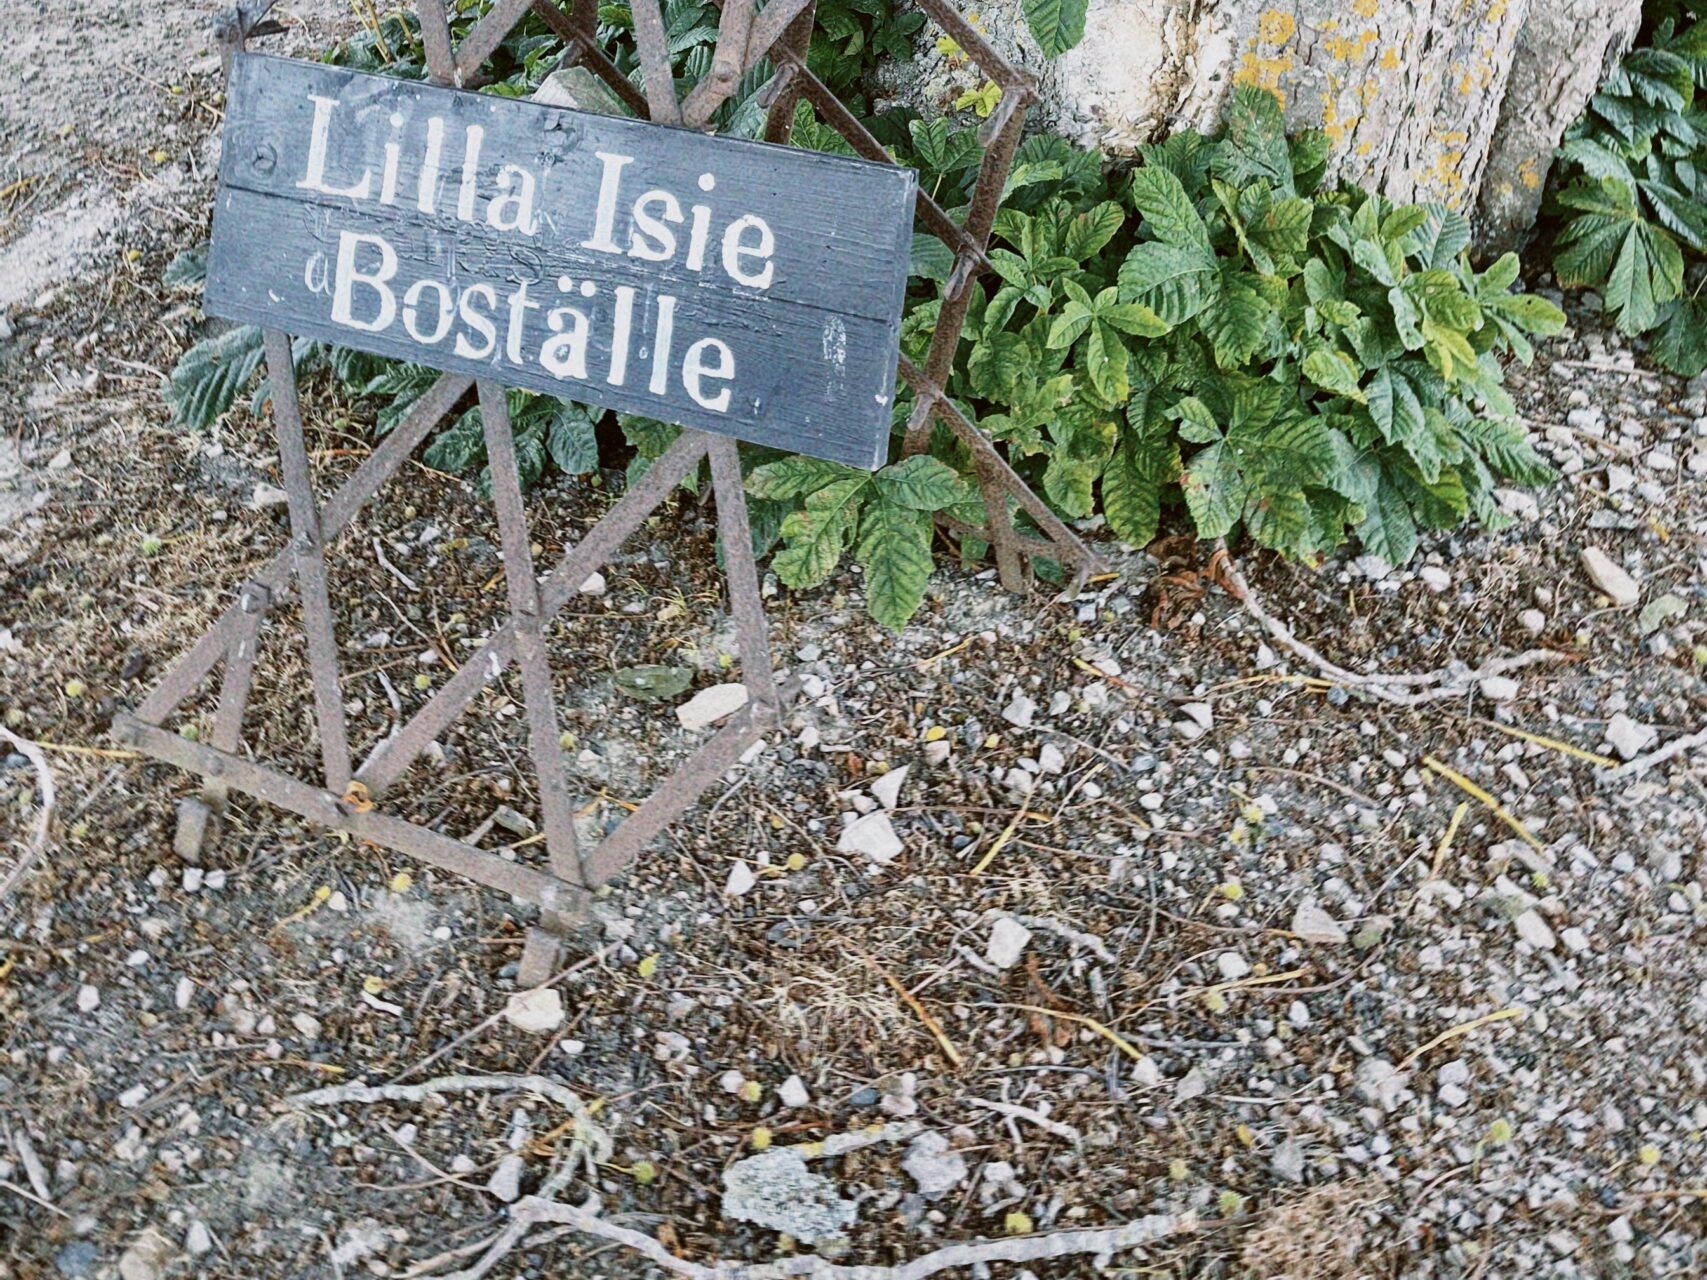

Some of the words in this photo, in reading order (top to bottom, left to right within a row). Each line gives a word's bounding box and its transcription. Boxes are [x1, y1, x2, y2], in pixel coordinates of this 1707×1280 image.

[296, 94, 536, 236] Lilla
[581, 151, 776, 290] Isie
[330, 231, 737, 413] Boställe
